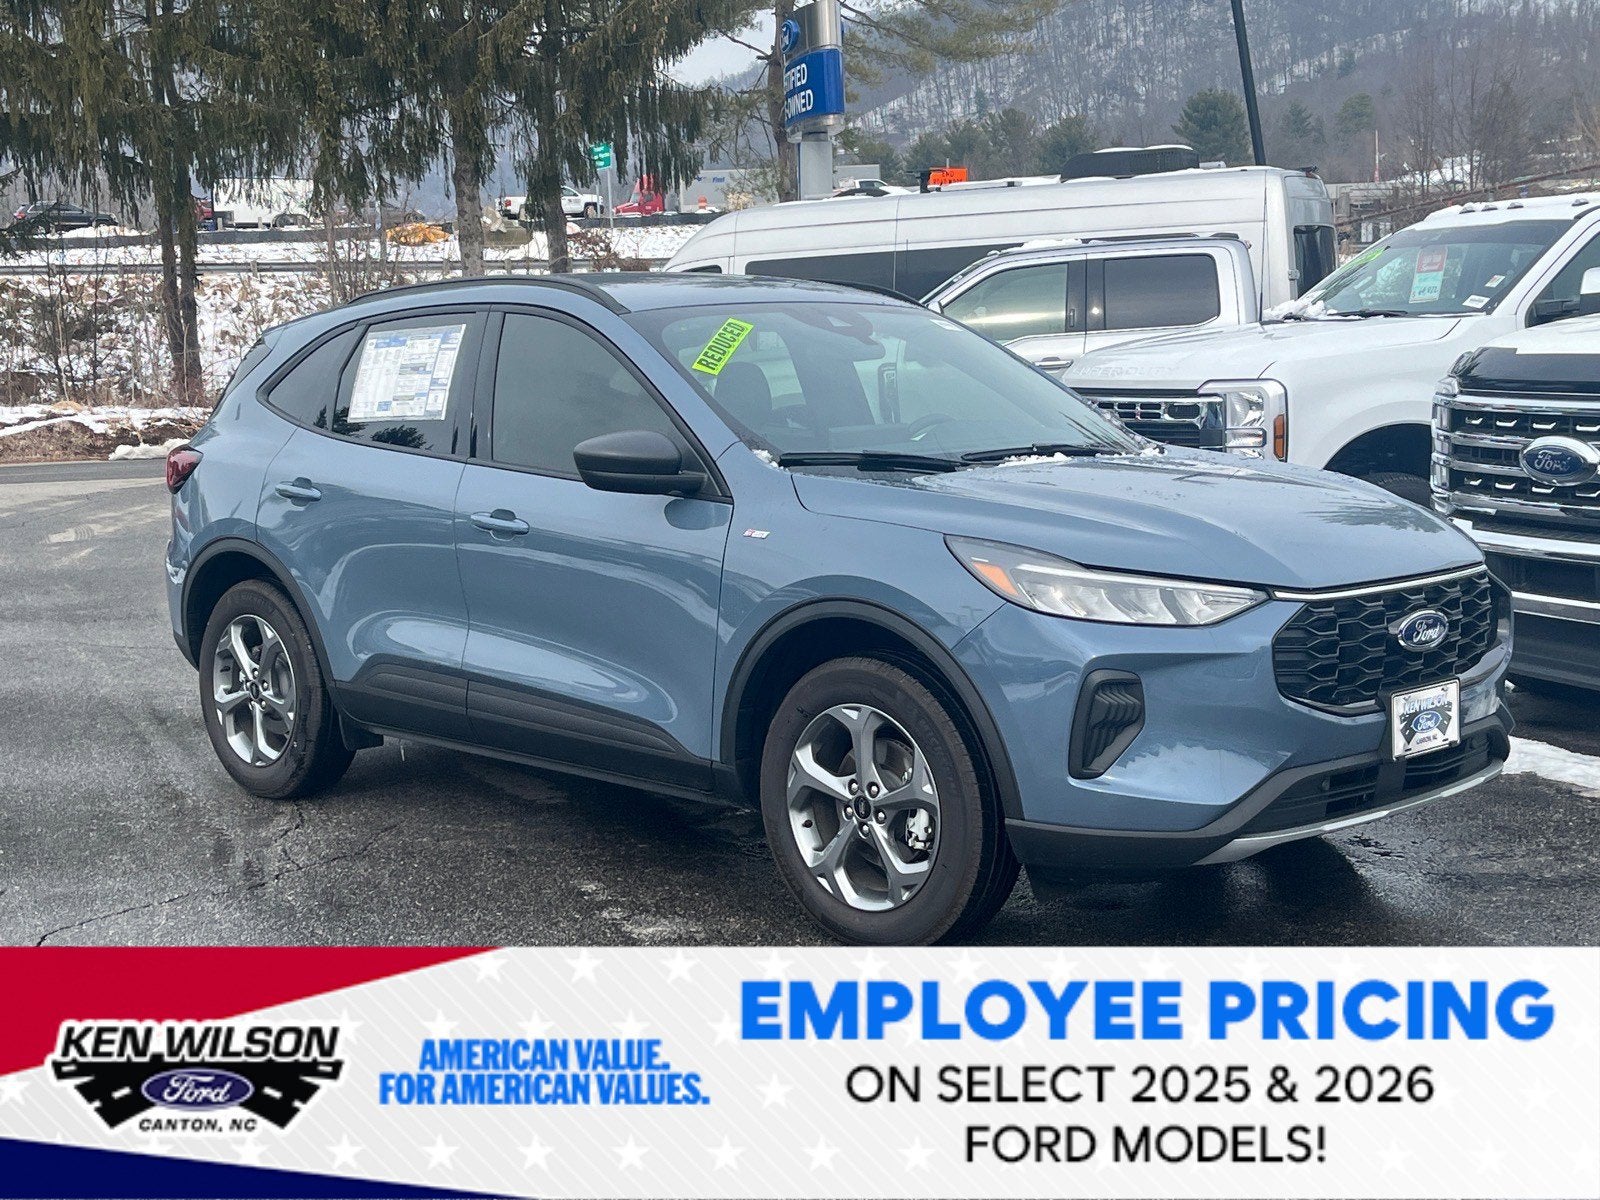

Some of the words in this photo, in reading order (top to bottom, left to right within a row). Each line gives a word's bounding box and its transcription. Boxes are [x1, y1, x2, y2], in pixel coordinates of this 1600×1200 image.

[696, 321, 746, 371] REDUCED
[1534, 449, 1572, 472] Ford
[1413, 619, 1441, 643] Ford
[1404, 699, 1420, 715] KEN
[1417, 713, 1437, 731] Ford
